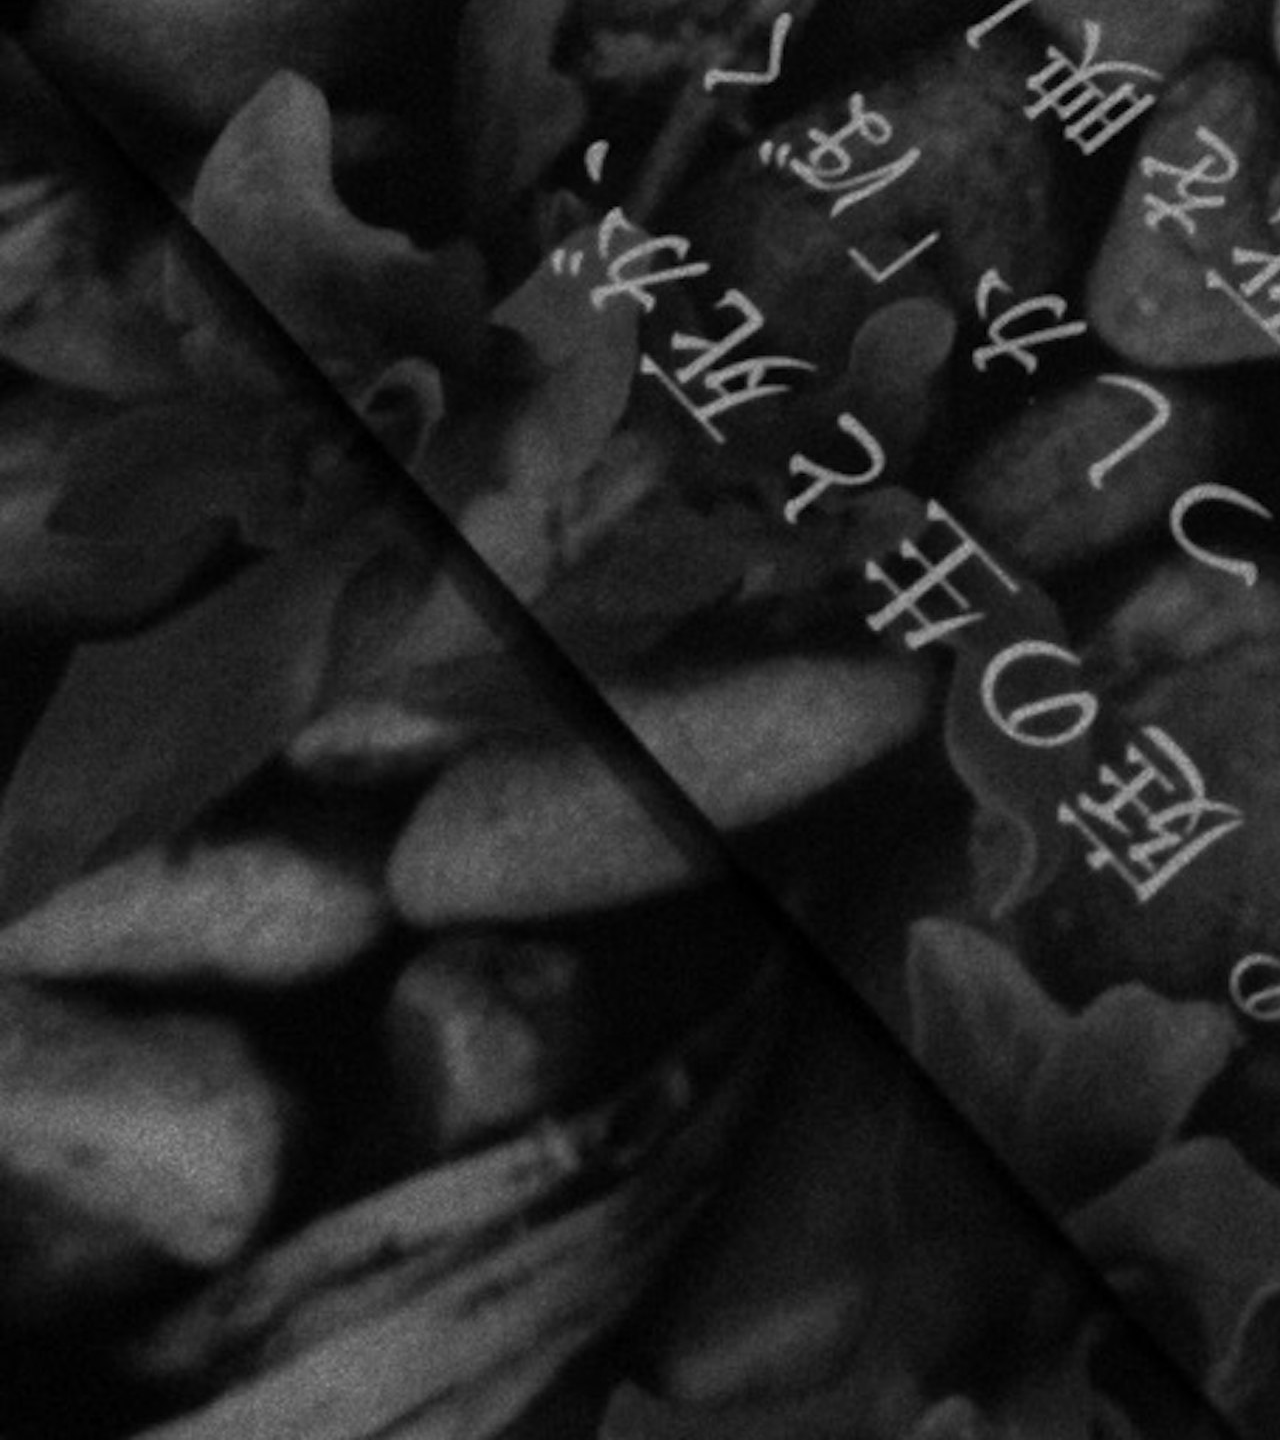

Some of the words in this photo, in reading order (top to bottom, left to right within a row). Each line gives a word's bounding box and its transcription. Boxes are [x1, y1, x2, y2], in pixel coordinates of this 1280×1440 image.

[551, 139, 1244, 905] 庭の生と死が、
